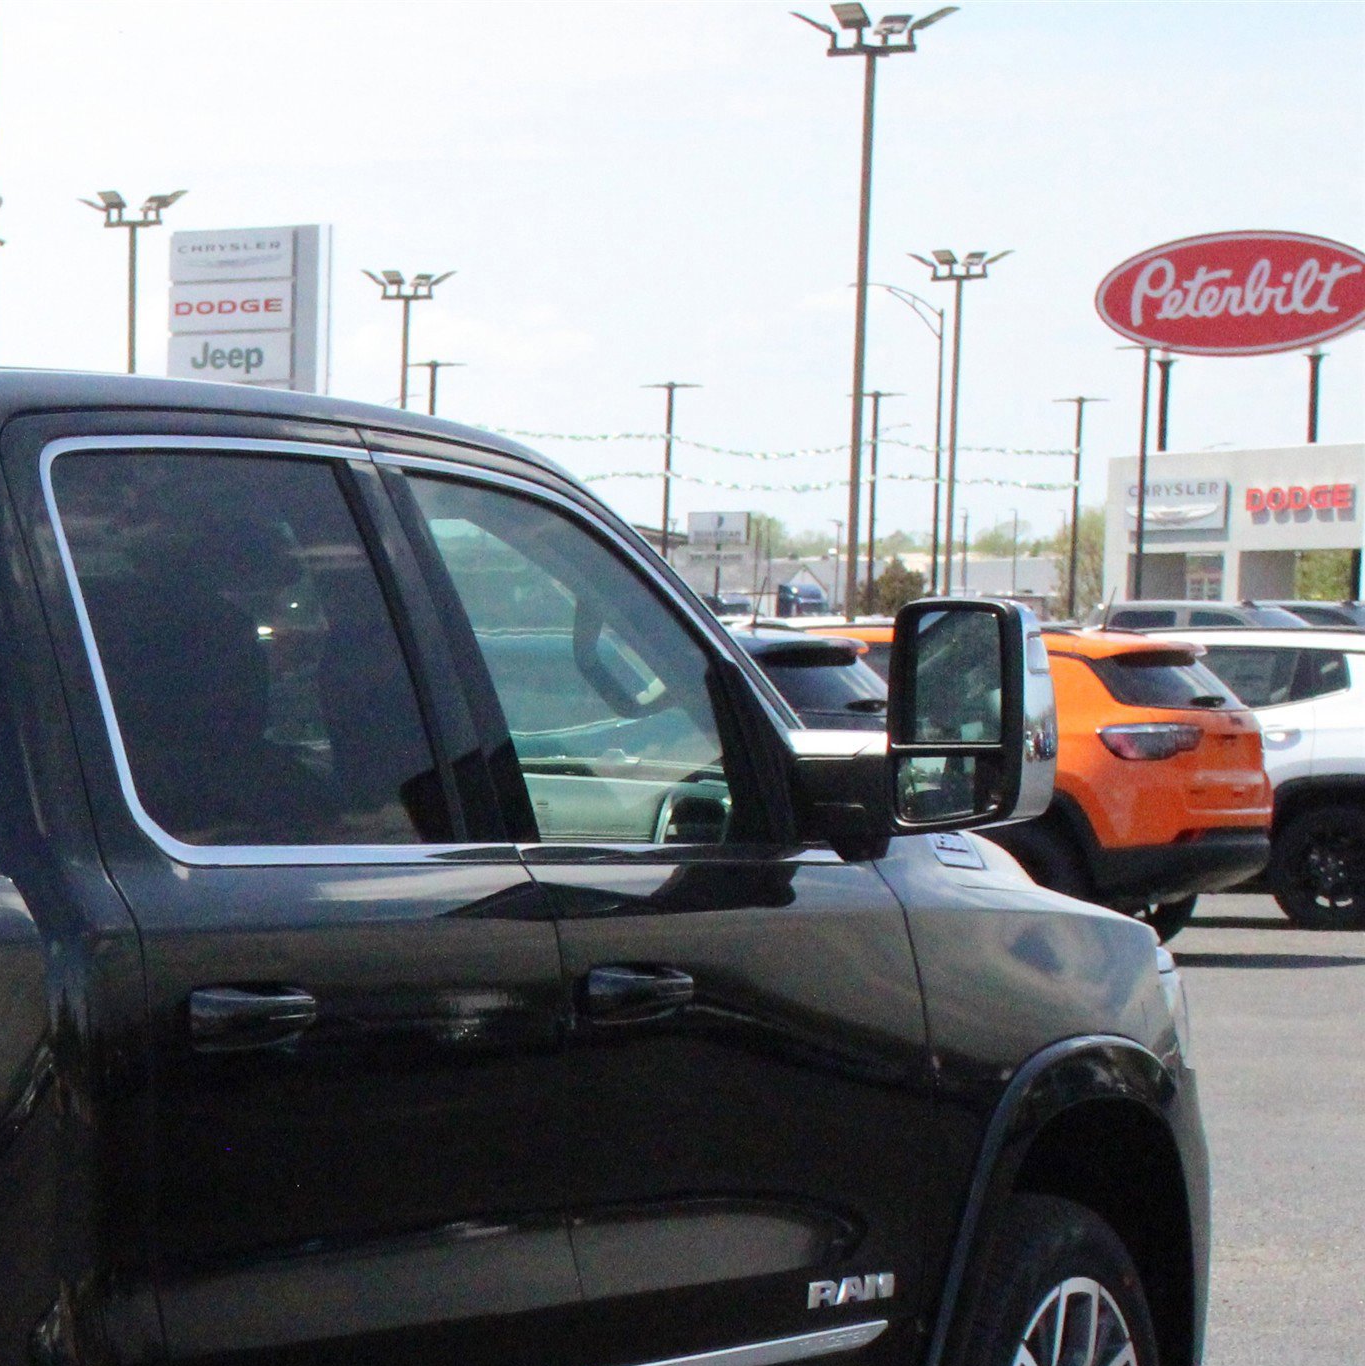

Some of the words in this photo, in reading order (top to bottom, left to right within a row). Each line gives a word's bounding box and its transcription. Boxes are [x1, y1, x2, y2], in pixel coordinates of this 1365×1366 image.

[177, 240, 281, 254] CHRYSLER
[174, 297, 283, 316] DODGE
[1131, 257, 1362, 327] Peterbilt
[190, 341, 264, 374] Jeep
[1245, 483, 1352, 512] DODGE
[807, 1272, 895, 1309] RAM
